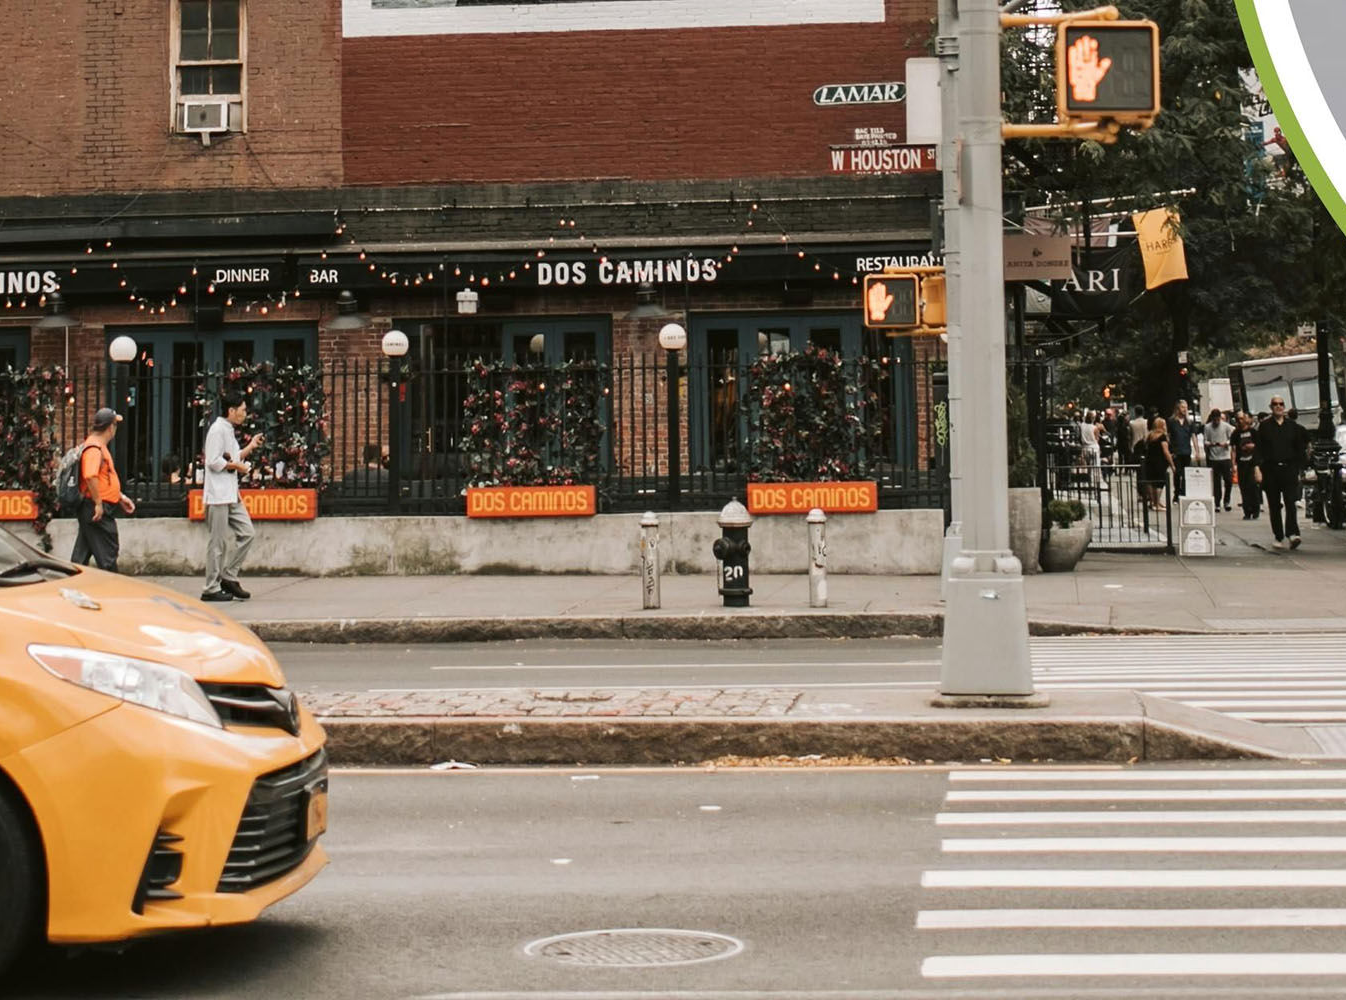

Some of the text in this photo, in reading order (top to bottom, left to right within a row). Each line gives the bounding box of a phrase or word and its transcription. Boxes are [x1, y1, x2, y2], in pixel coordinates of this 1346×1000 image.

[819, 84, 899, 103] LAMAR
[831, 151, 845, 171] W
[851, 148, 922, 171] HOUSTON
[538, 258, 718, 286] DOS CAMINOS
[856, 255, 946, 272] RESTAURAN
[216, 268, 270, 283] DINNER
[310, 269, 338, 283] BAR
[245, 495, 308, 515] AMINOS
[473, 491, 587, 511] DOS CAMINOS
[752, 487, 870, 509] DOS CAMINOS
